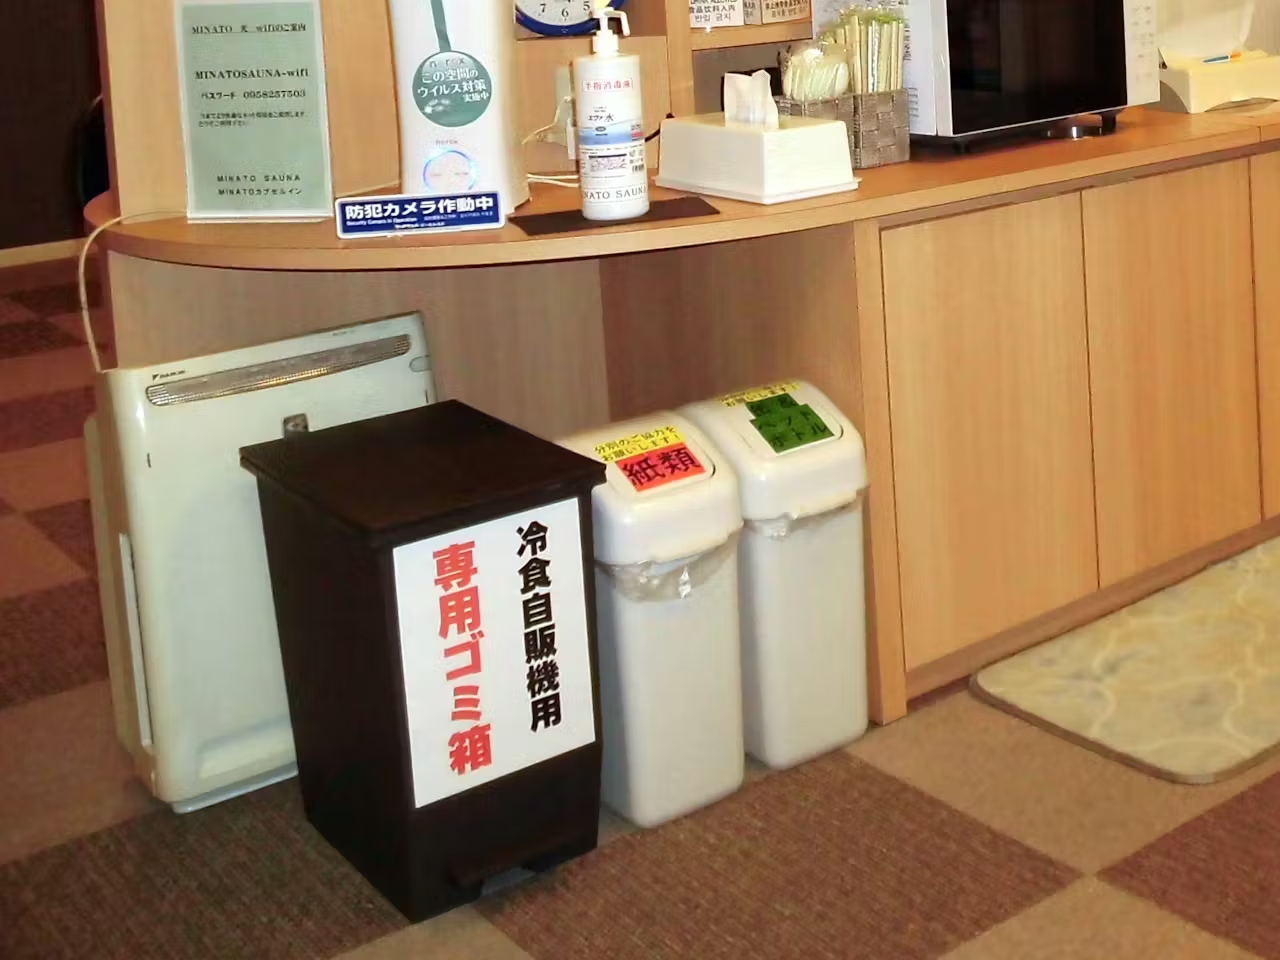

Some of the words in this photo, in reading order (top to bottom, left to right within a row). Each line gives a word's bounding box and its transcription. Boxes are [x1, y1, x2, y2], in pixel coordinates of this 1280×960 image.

[539, 3, 547, 13] 7
[583, 1, 591, 11] 5
[561, 8, 569, 18] 6
[192, 25, 232, 34] MINATO
[195, 68, 309, 80] MINATOSAUNA-wifi
[422, 68, 478, 83] この空間の
[417, 79, 487, 98] ウイルス対策
[201, 91, 236, 100] パスワード
[463, 91, 489, 102] 実施中
[217, 174, 256, 182] MINATO
[264, 174, 300, 182] SAUNA
[218, 188, 302, 196] MINATOカプセルイン
[345, 196, 494, 220] 防犯カメラ作動中
[594, 426, 676, 454] 分別のご協力を
[621, 446, 701, 486] 紙類
[516, 520, 562, 732] 冷食自販機用
[432, 540, 492, 775] 専用ゴミ箱
